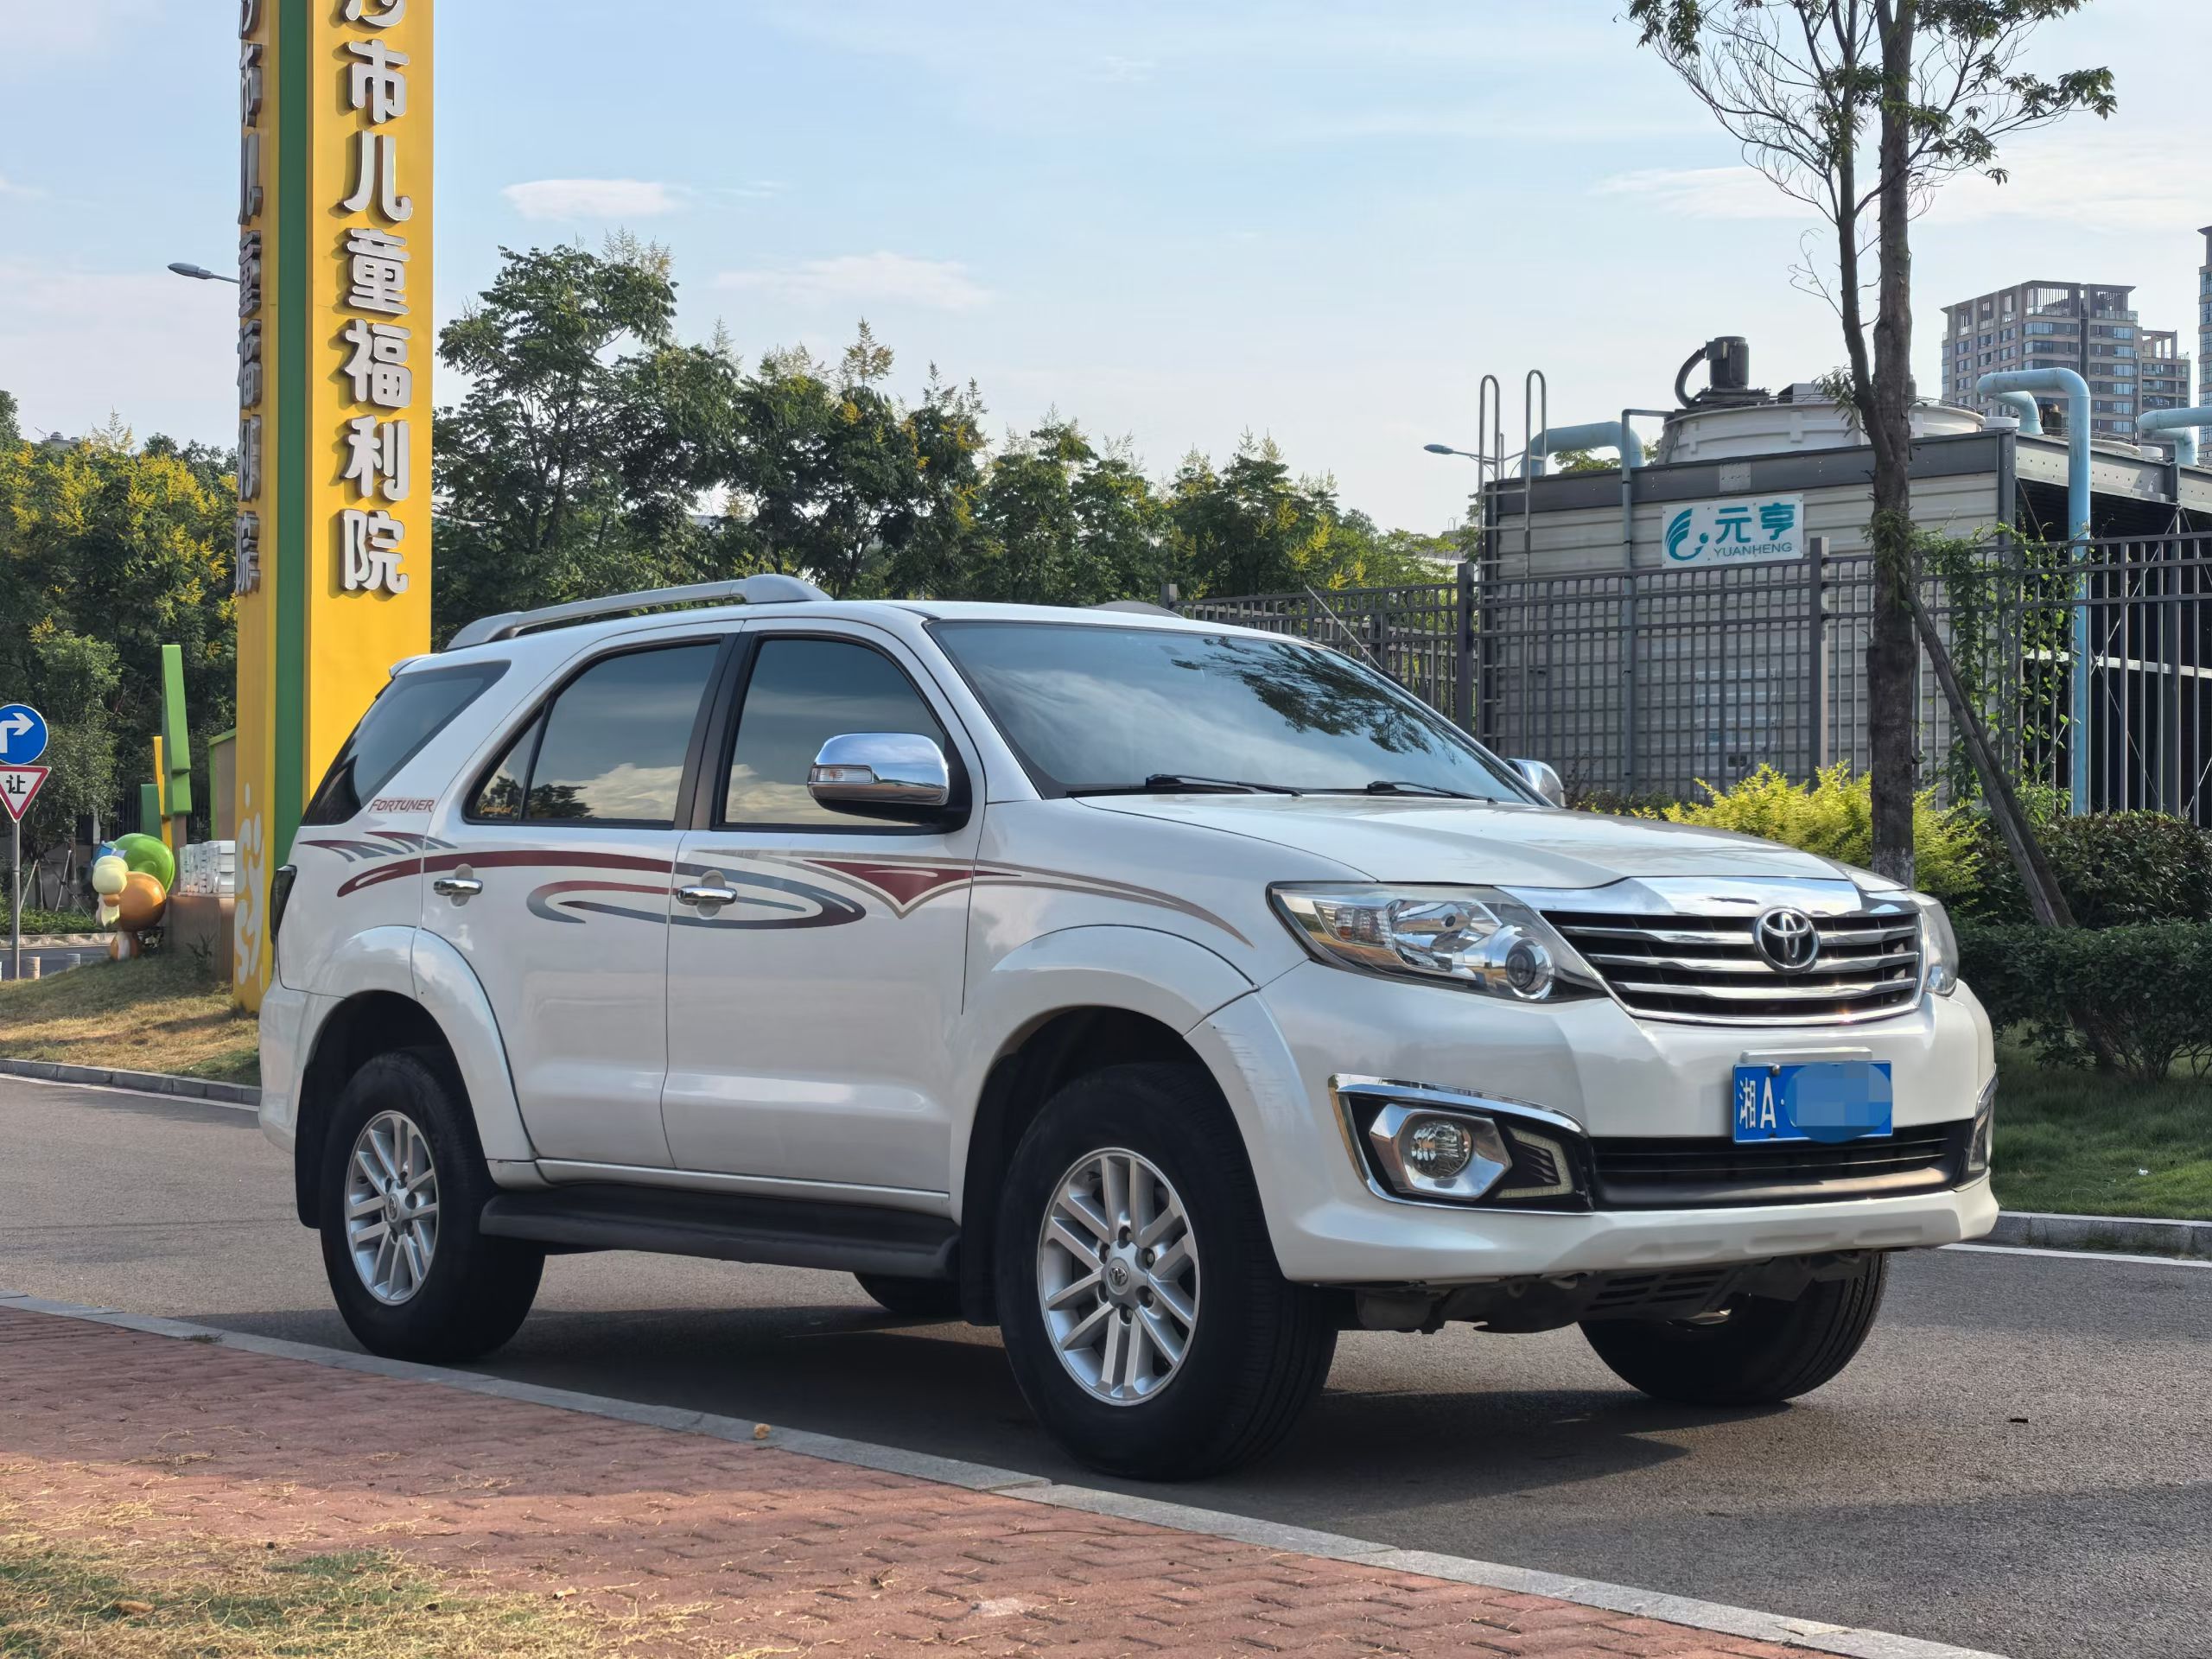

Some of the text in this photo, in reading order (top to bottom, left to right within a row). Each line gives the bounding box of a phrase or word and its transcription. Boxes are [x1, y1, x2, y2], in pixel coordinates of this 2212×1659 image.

[1715, 502, 1796, 544] 元亨
[1713, 542, 1793, 557] YUANHENG
[6, 774, 26, 794] 让
[368, 798, 435, 813] FORTUNER
